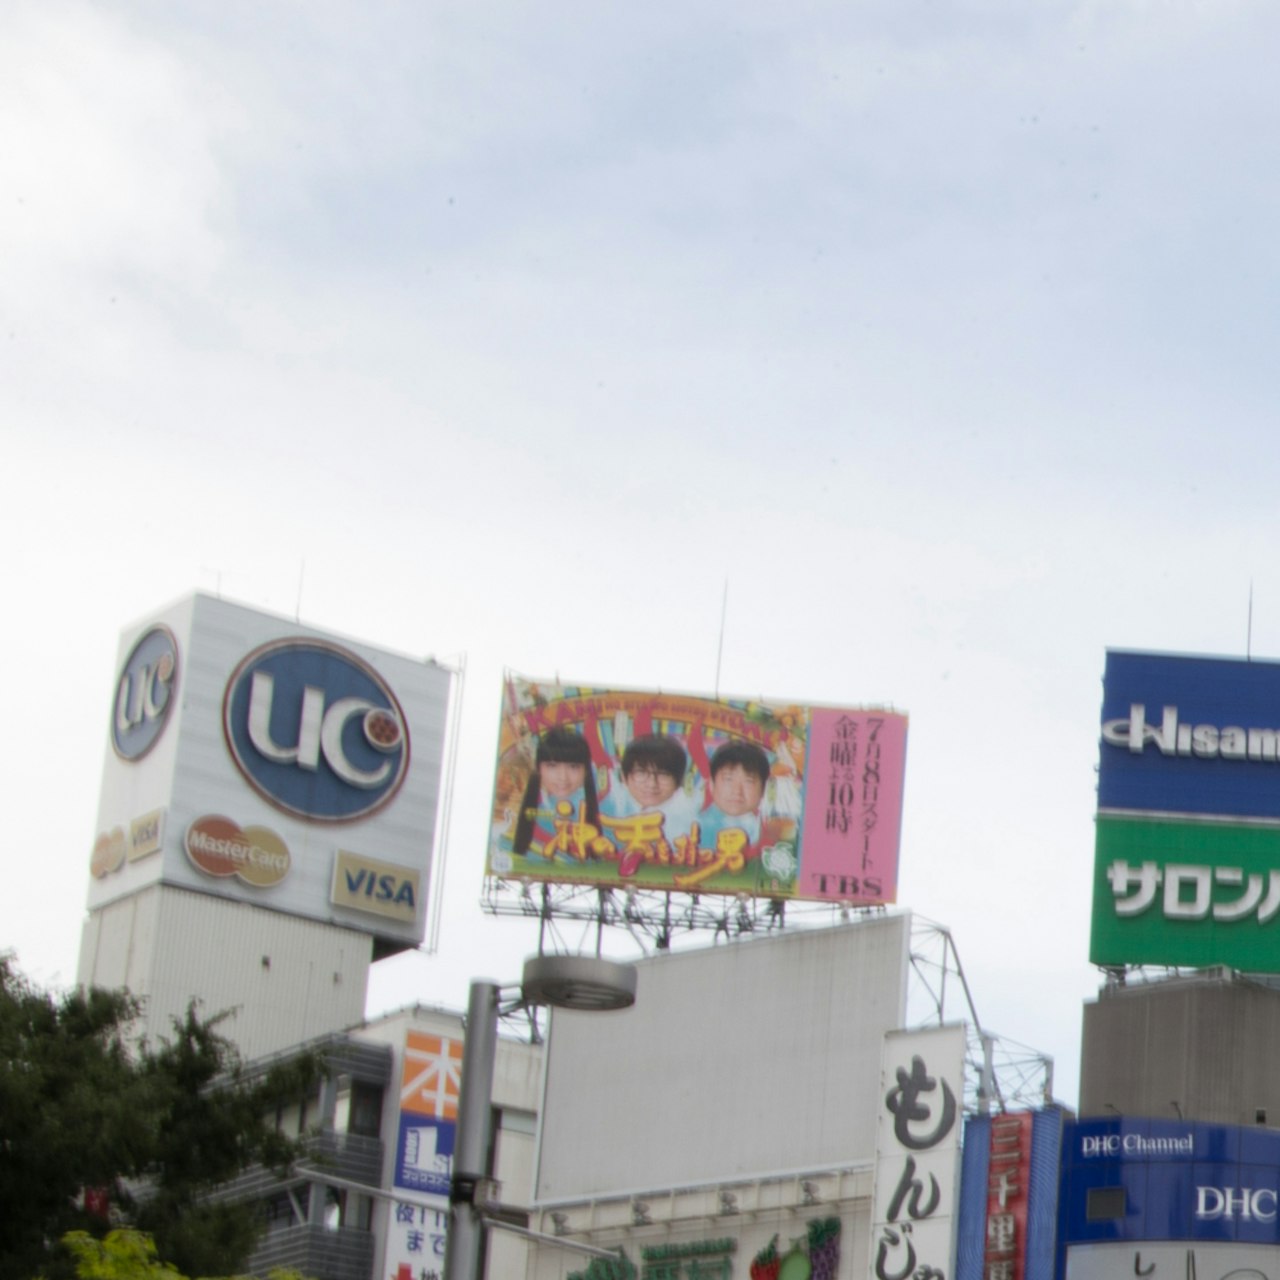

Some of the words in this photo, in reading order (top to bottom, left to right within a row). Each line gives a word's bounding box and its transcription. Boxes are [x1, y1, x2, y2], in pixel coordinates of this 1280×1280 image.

[248, 671, 398, 789] UC
[189, 830, 289, 870] MasterCard
[345, 868, 416, 907] VISA
[811, 872, 883, 897] TBS
[1083, 1135, 1120, 1152] DHC
[1123, 1133, 1194, 1154] Channel
[1196, 1186, 1278, 1220] DHC
